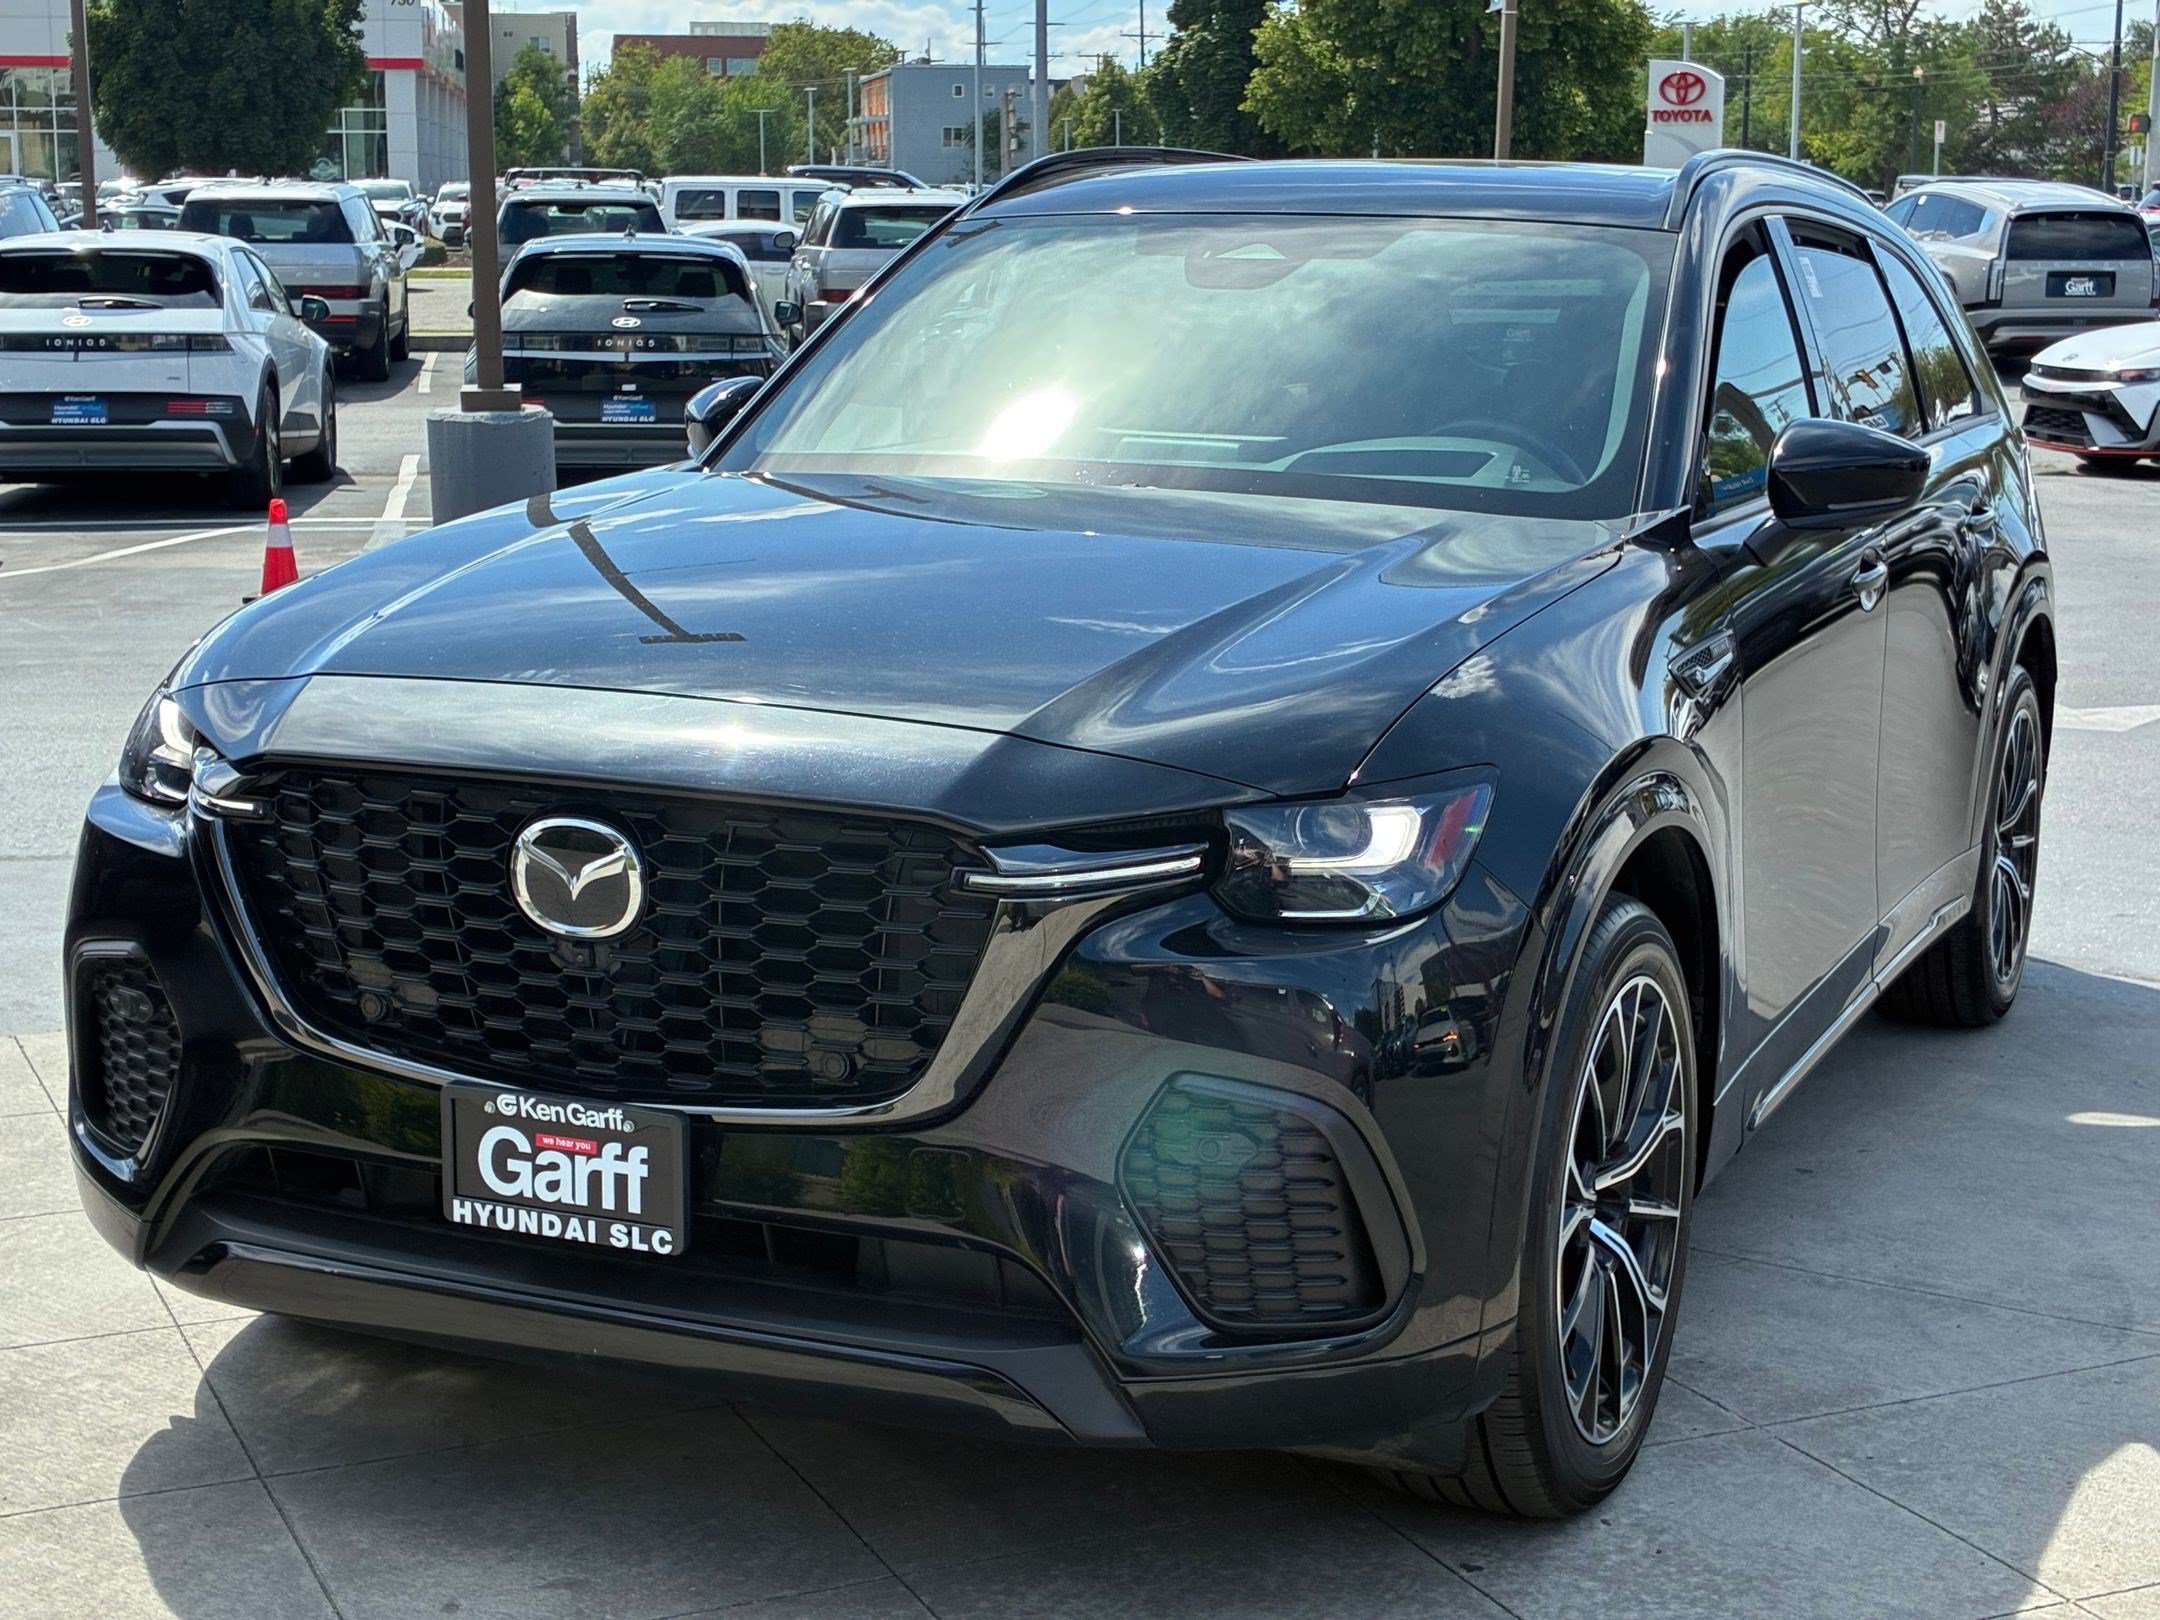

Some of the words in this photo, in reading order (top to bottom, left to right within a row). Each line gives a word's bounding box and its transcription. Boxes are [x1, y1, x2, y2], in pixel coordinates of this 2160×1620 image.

[1650, 109, 1713, 123] TOYOTA
[2065, 281, 2093, 292] Garff
[51, 416, 89, 424] HYUNDAI
[90, 416, 107, 424] SLC
[542, 1136, 555, 1145] we
[556, 1136, 574, 1149] hear
[575, 1140, 591, 1152] you
[477, 1125, 649, 1215] Garff
[452, 1199, 596, 1244] HYUNDAI
[609, 1223, 673, 1255] SLC
